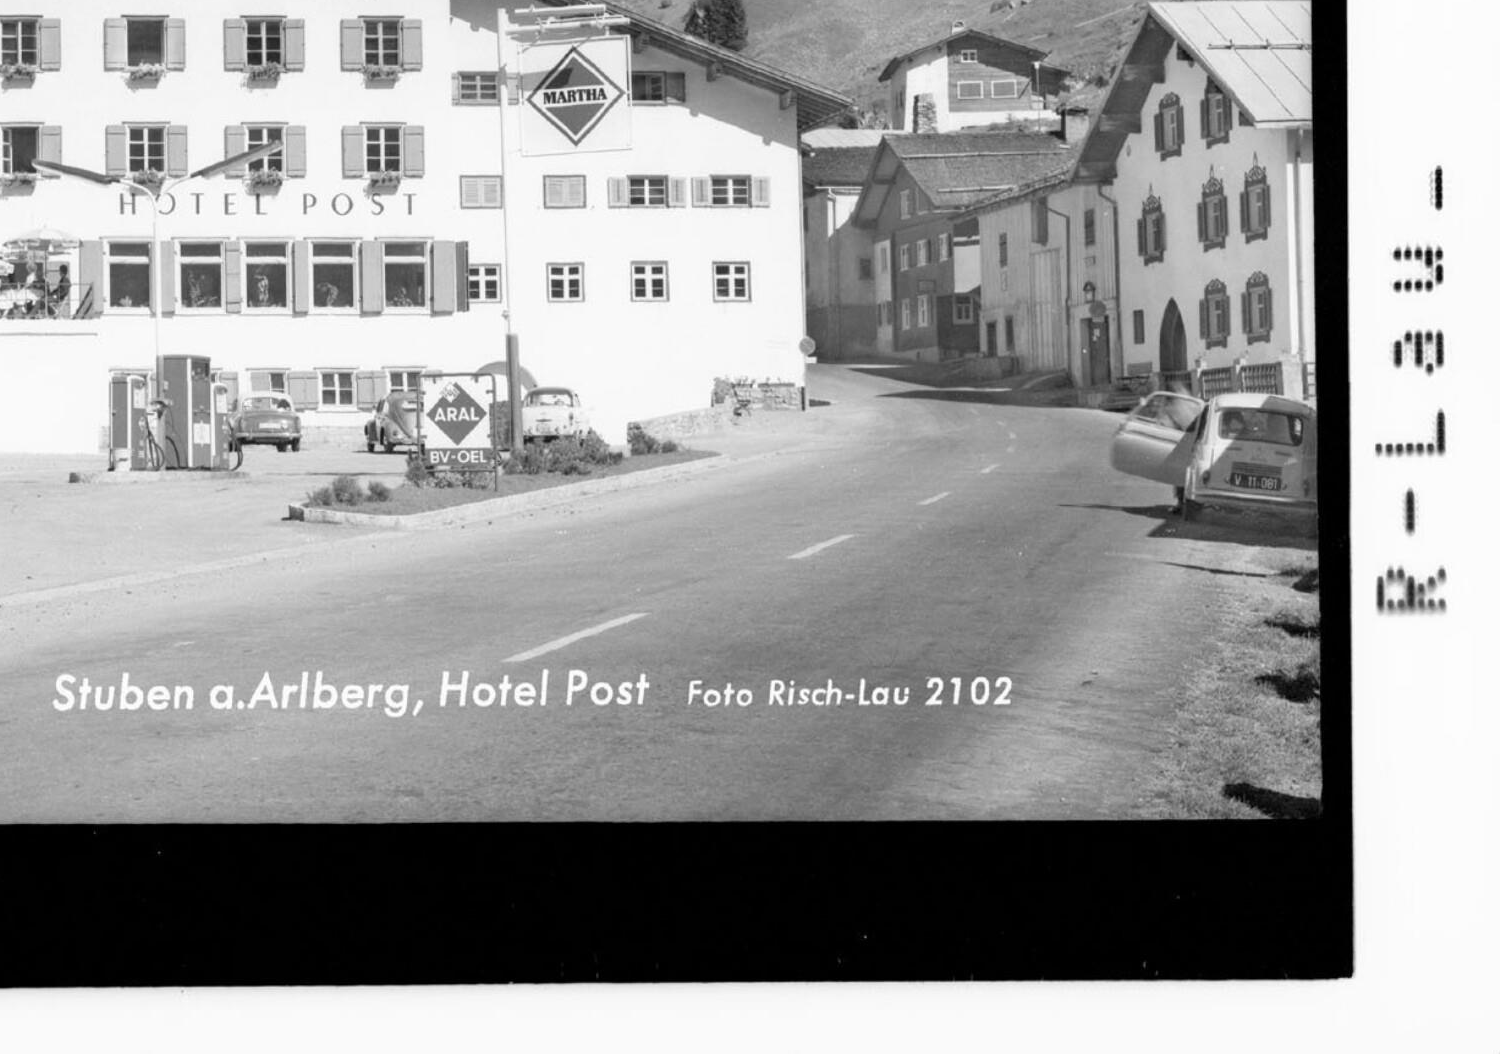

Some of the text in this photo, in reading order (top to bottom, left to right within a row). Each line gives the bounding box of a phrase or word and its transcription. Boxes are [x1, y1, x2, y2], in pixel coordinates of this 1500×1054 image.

[542, 86, 608, 105] MARTHA
[118, 192, 418, 216] HOTEL POST
[434, 406, 480, 422] ARAL
[429, 449, 488, 464] BV-OEL
